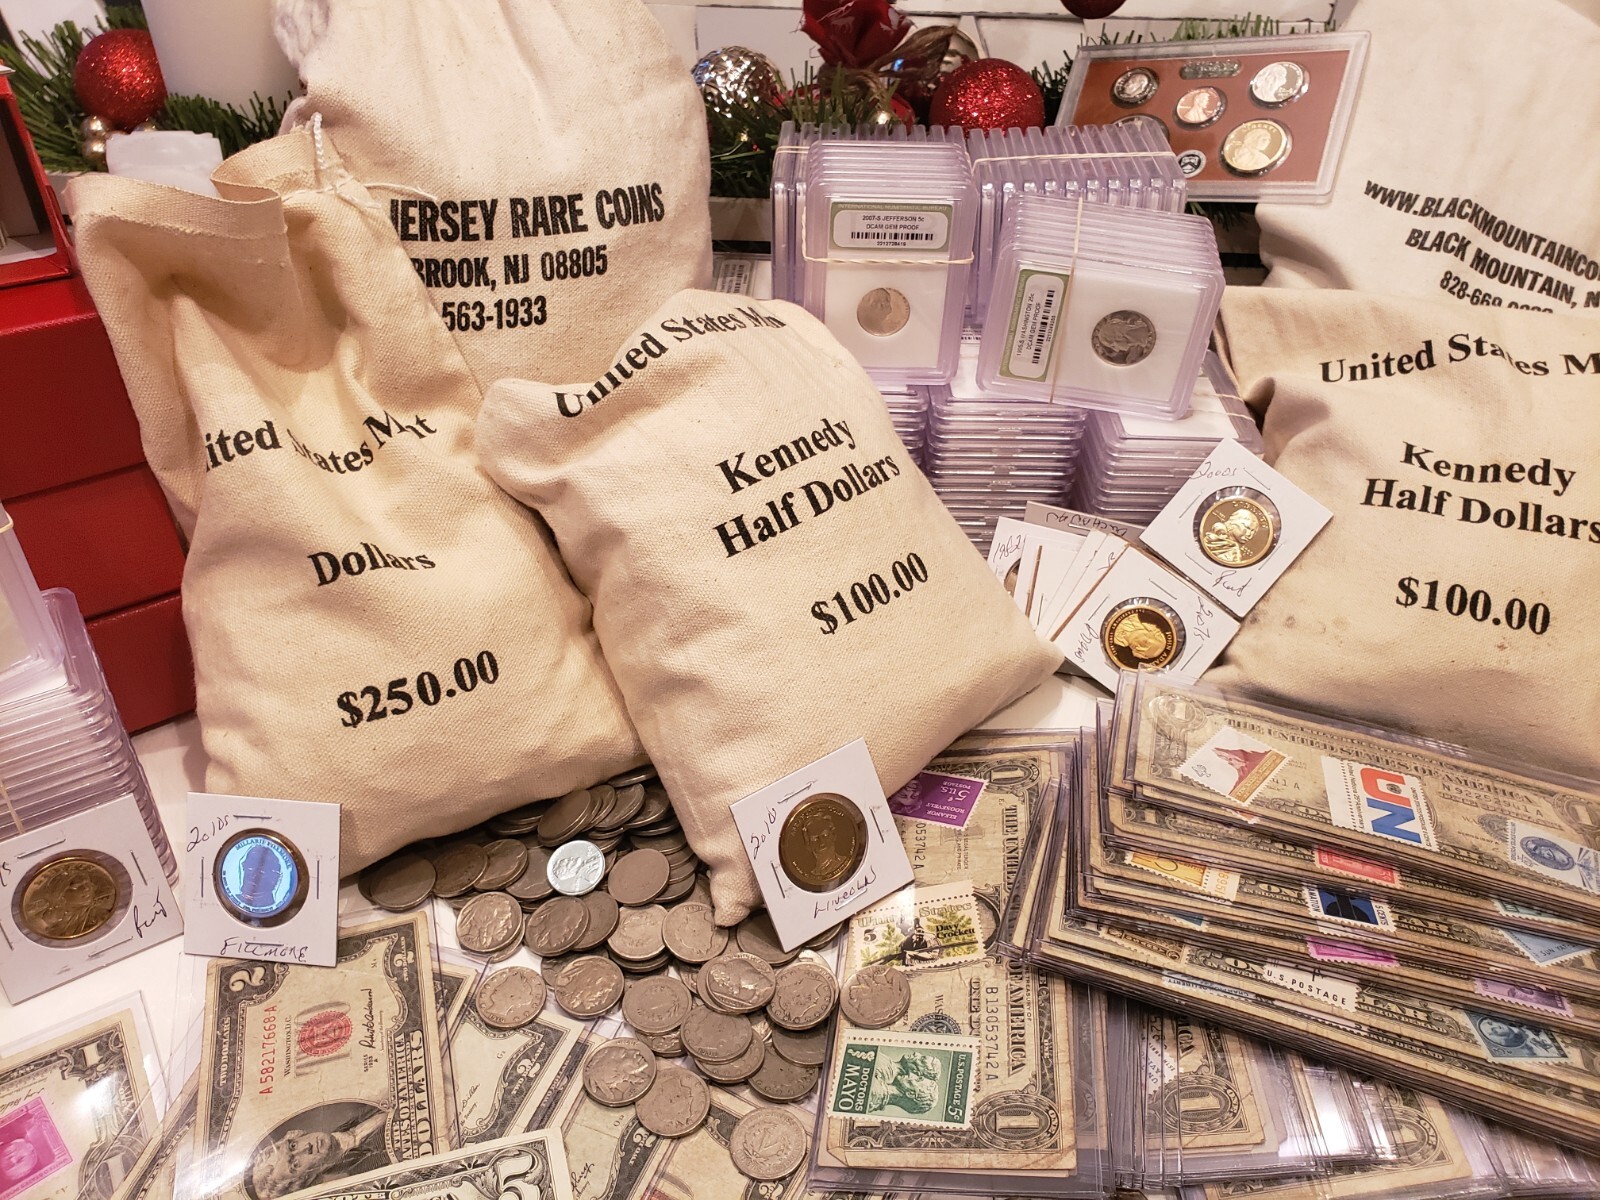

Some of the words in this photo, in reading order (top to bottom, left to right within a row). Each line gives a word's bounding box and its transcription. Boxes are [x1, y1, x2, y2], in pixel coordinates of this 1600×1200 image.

[510, 193, 588, 238] RARE
[596, 182, 665, 230] COINS
[504, 253, 529, 285] NJ
[541, 244, 608, 281] 08805
[1405, 228, 1472, 262] BLACK
[1469, 247, 1578, 309] MOUNTAIN,
[441, 295, 548, 332] 563-1933
[660, 316, 746, 343] States
[1020, 303, 1032, 338] WASHINGTON
[1030, 322, 1038, 334] GEM
[1033, 302, 1041, 321] PROOF
[1319, 340, 1437, 383] United
[205, 420, 282, 473] ited
[715, 418, 857, 494] Kennedy
[1400, 441, 1577, 497] Kennedy
[712, 491, 802, 558] Half
[798, 456, 901, 517] Dollars
[1360, 478, 1453, 517] Half
[1457, 496, 1600, 544] Dollars
[308, 542, 436, 586] Dollars
[811, 552, 929, 635] $100.00
[1396, 576, 1550, 635] $100.00
[1165, 631, 1174, 651] JOHN
[336, 649, 500, 729] $250.00
[1224, 717, 1265, 735] THE
[1266, 726, 1339, 751] UNITED
[1442, 772, 1534, 805] AMERICA
[942, 780, 971, 790] POSTAGE
[1360, 768, 1422, 844] UN
[926, 802, 966, 814] ROOSEVELT
[926, 810, 957, 820] ELEANOR
[1004, 804, 1018, 836] THE
[913, 822, 927, 870] 053742A
[918, 901, 973, 918] States
[936, 922, 961, 934] Davy
[863, 928, 877, 942] 5
[936, 928, 976, 940] Crockett
[1540, 946, 1556, 958] SUN
[1291, 979, 1348, 1006] POSTAGE
[222, 1017, 230, 1063] DOLLARS
[1007, 981, 1026, 1078] AMERICA
[392, 1032, 412, 1098] AMERICA
[522, 1041, 547, 1078] DOLLARS
[404, 1030, 439, 1157] DOLLARS
[838, 1064, 860, 1111] MAYO
[854, 1066, 871, 1113] DOCTORS
